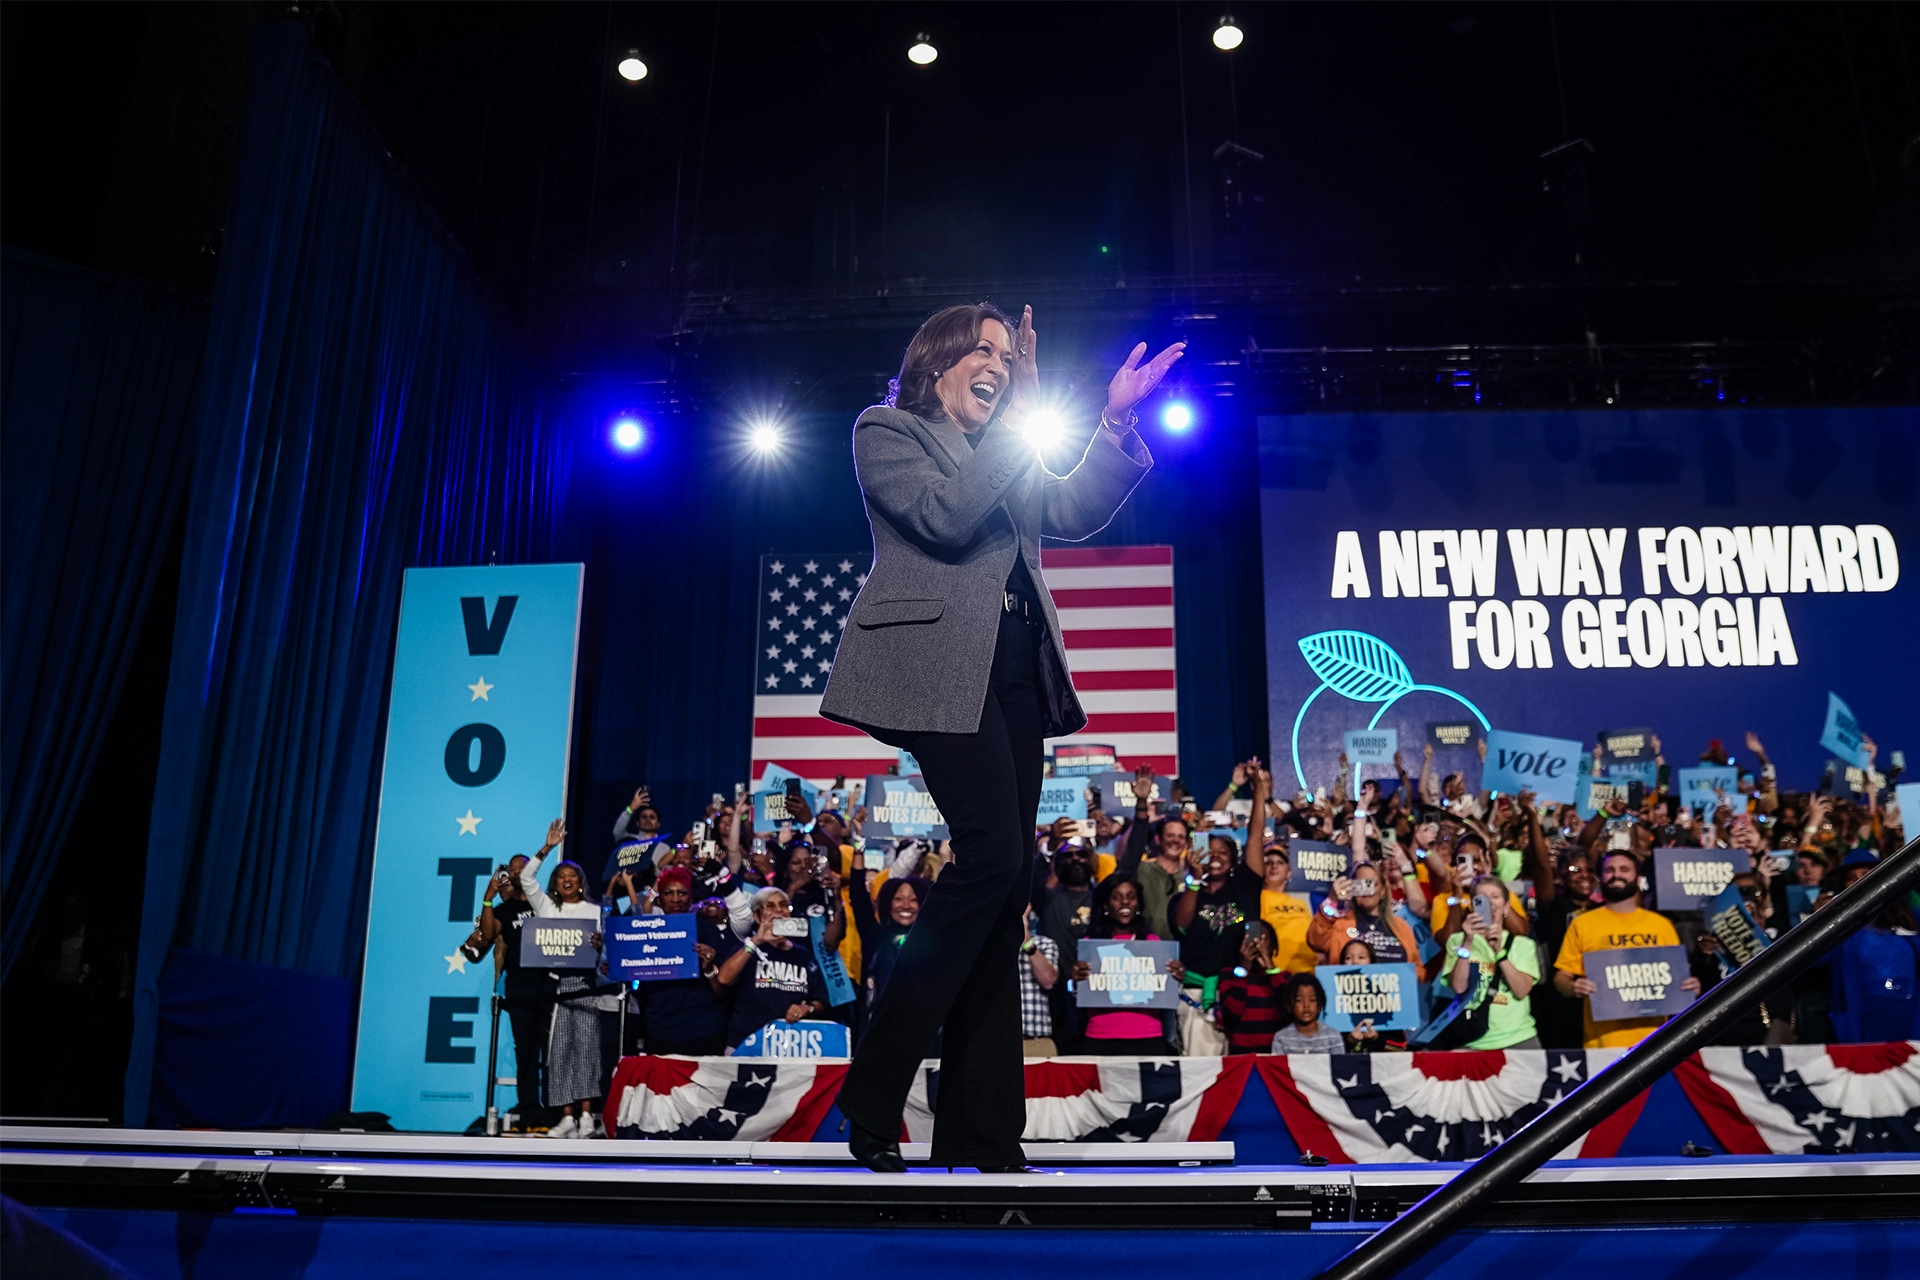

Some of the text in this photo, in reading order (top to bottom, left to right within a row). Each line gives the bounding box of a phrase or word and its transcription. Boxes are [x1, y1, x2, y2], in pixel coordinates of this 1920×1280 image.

[1331, 524, 1900, 599] A NEW WAY FORWARD
[1448, 597, 1799, 670] FOR GEORGIA
[1435, 726, 1471, 739] HARRIS
[1442, 737, 1467, 745] WALZ
[1352, 737, 1387, 749] HARRIS
[1607, 734, 1645, 751] HARRIS
[1358, 749, 1382, 757] WALZ
[1613, 748, 1640, 758] WALZ
[1497, 748, 1567, 779] vote
[1041, 788, 1075, 803] ARRIS
[873, 806, 911, 823] VOTES
[424, 595, 520, 1065] VOTE
[618, 854, 642, 867] WALZ
[1297, 851, 1347, 873] HARRIS
[1304, 869, 1339, 882] WALZ
[1673, 862, 1735, 883] HARRIS
[1683, 882, 1727, 896] WALZ
[631, 918, 666, 928] Georgia
[1723, 904, 1753, 939] VOTE
[535, 928, 583, 946] HARRIS
[615, 930, 687, 941] Women Veterans
[1609, 934, 1658, 946] UFCW
[1711, 912, 1751, 965] FREEDO
[542, 946, 576, 956] WALZ
[642, 944, 658, 953] for
[620, 956, 684, 967] Kamala Harris
[1100, 956, 1156, 974] ATLANTA
[755, 960, 808, 985] KAMALA
[1605, 962, 1673, 989] HARRIS
[755, 981, 770, 989] FOR
[1089, 974, 1168, 992] VOTES EARLY
[1334, 973, 1399, 993] VOTE FOR
[1618, 985, 1666, 1002] WALZ
[1335, 993, 1401, 1014] FREEDOM
